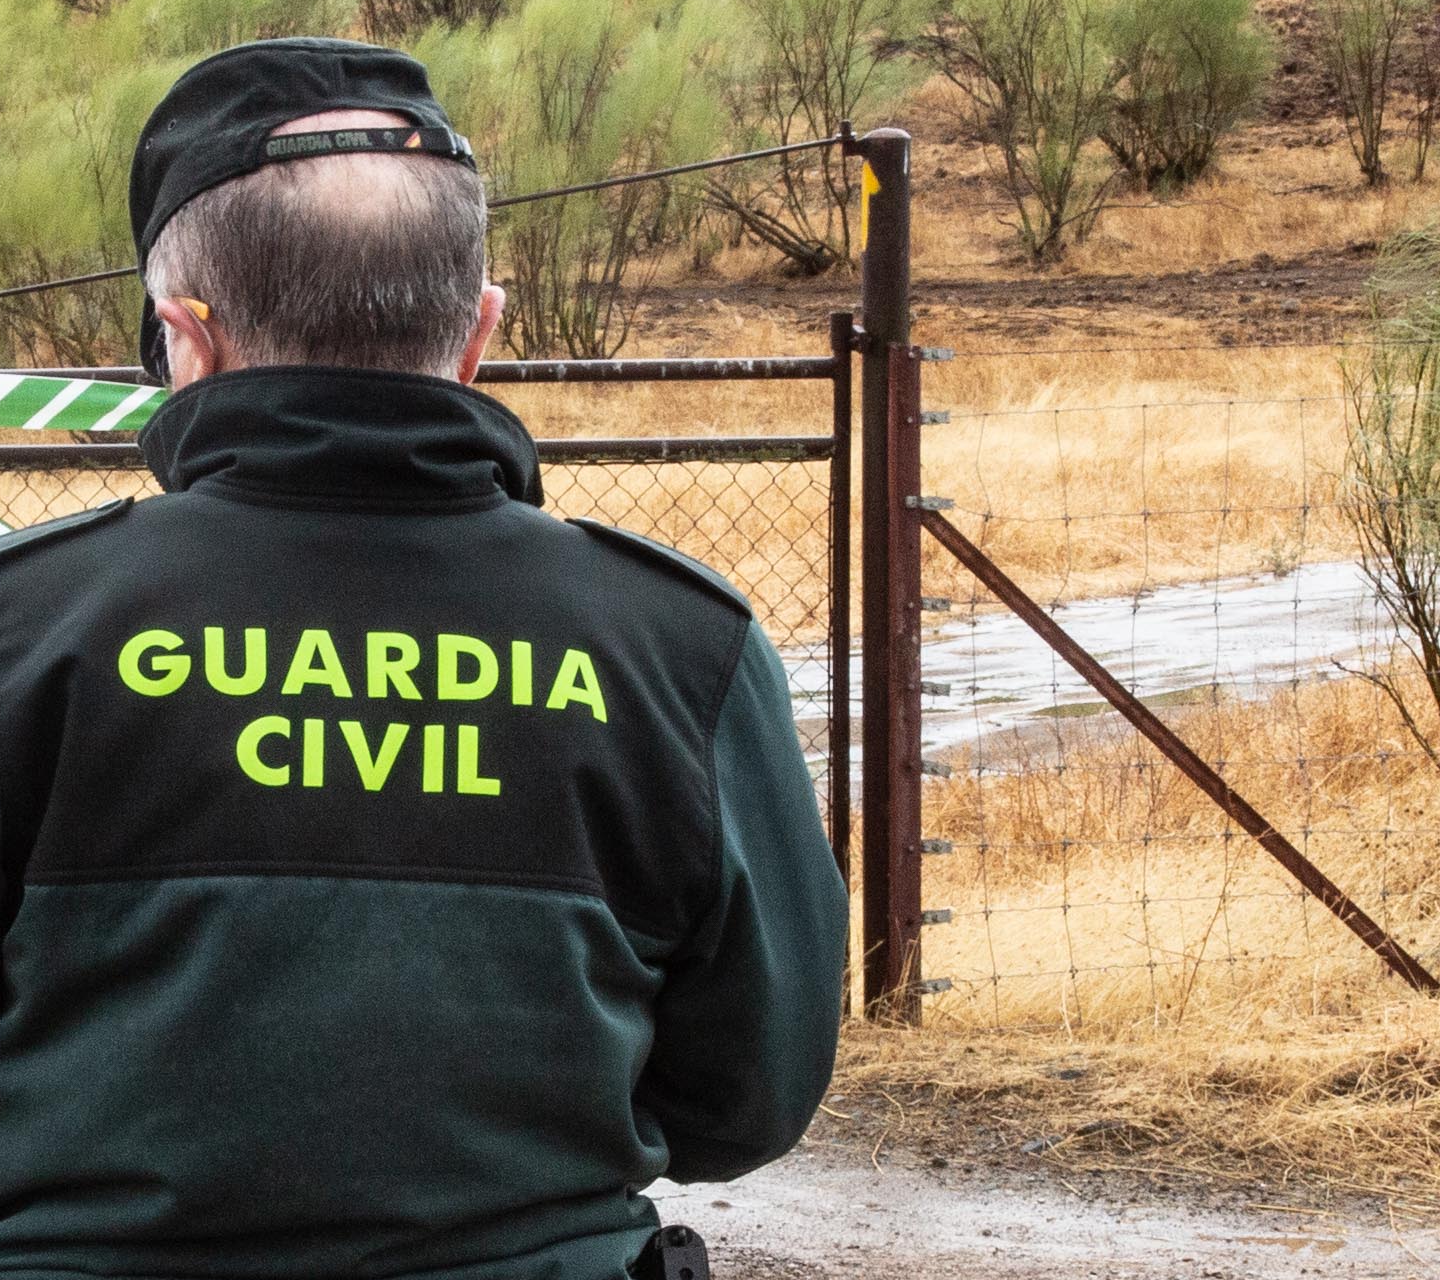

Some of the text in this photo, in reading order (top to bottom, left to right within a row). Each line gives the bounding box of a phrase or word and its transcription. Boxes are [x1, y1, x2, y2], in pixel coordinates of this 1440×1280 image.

[266, 131, 374, 157] GUARDIA CIVIL
[117, 626, 608, 723] GUARDIA
[235, 714, 501, 796] CIVIL
